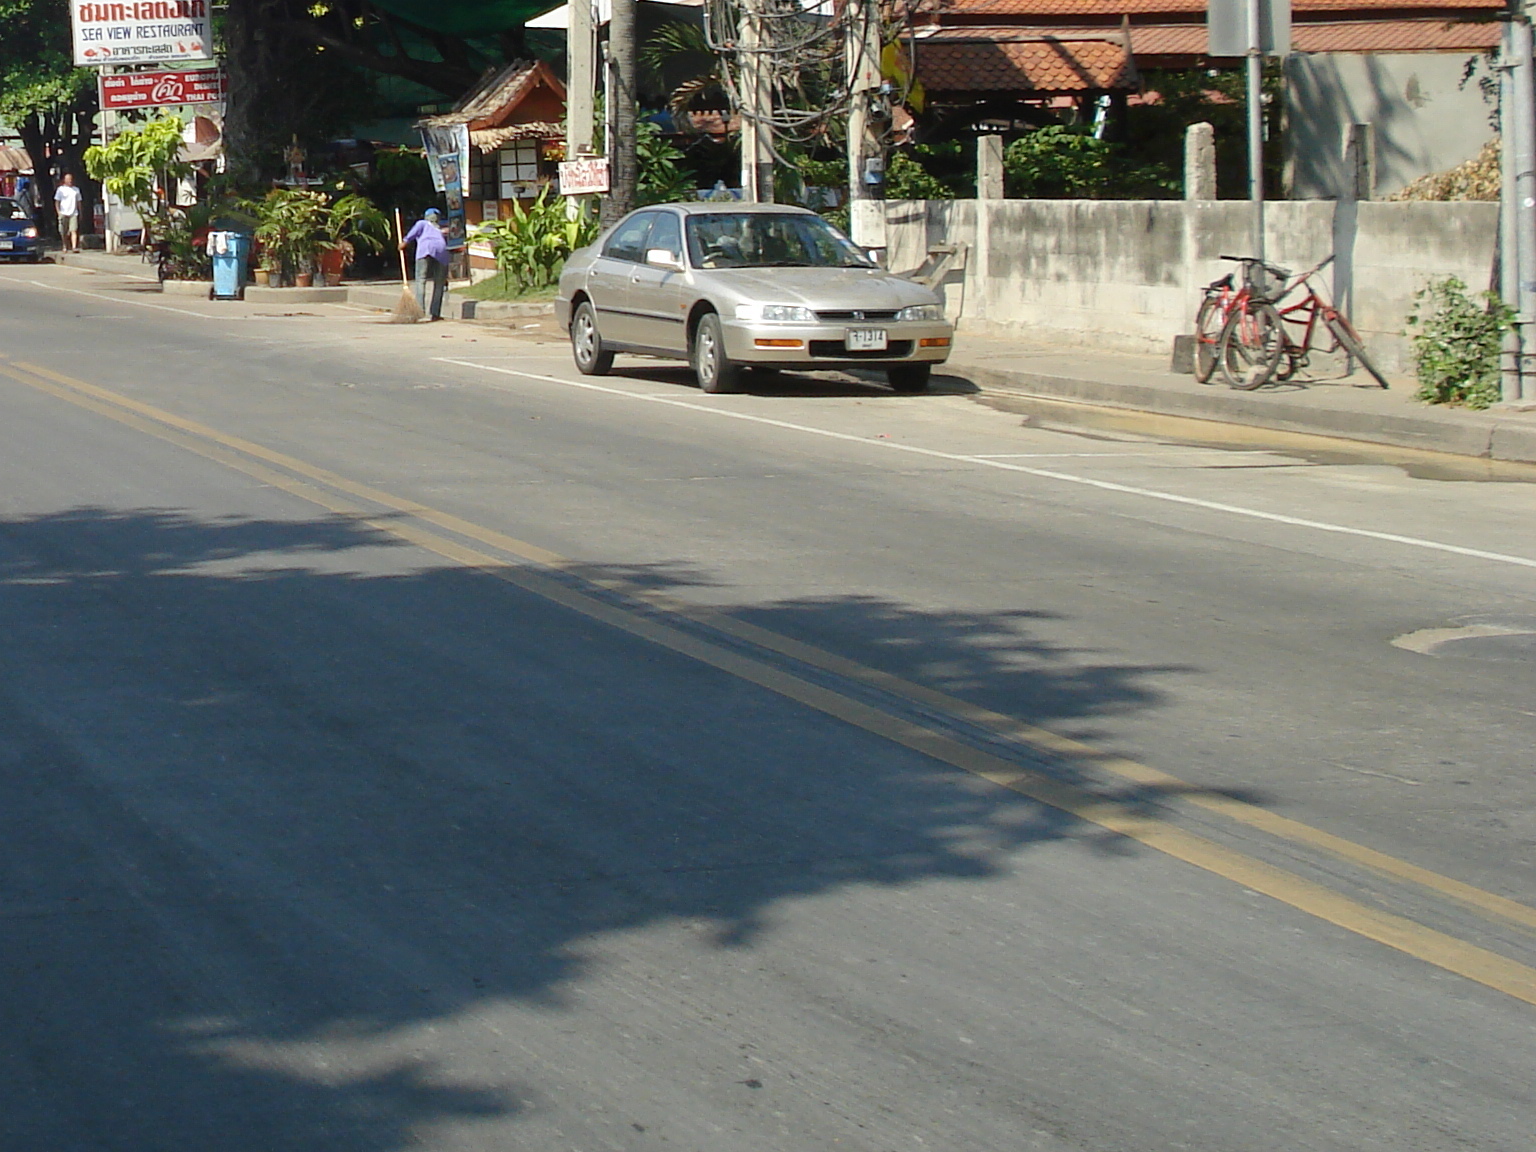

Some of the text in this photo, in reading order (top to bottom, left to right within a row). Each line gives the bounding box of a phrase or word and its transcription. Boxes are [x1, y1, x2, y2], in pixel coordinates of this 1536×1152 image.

[81, 23, 204, 41] SEA VIEW RESTAURANT
